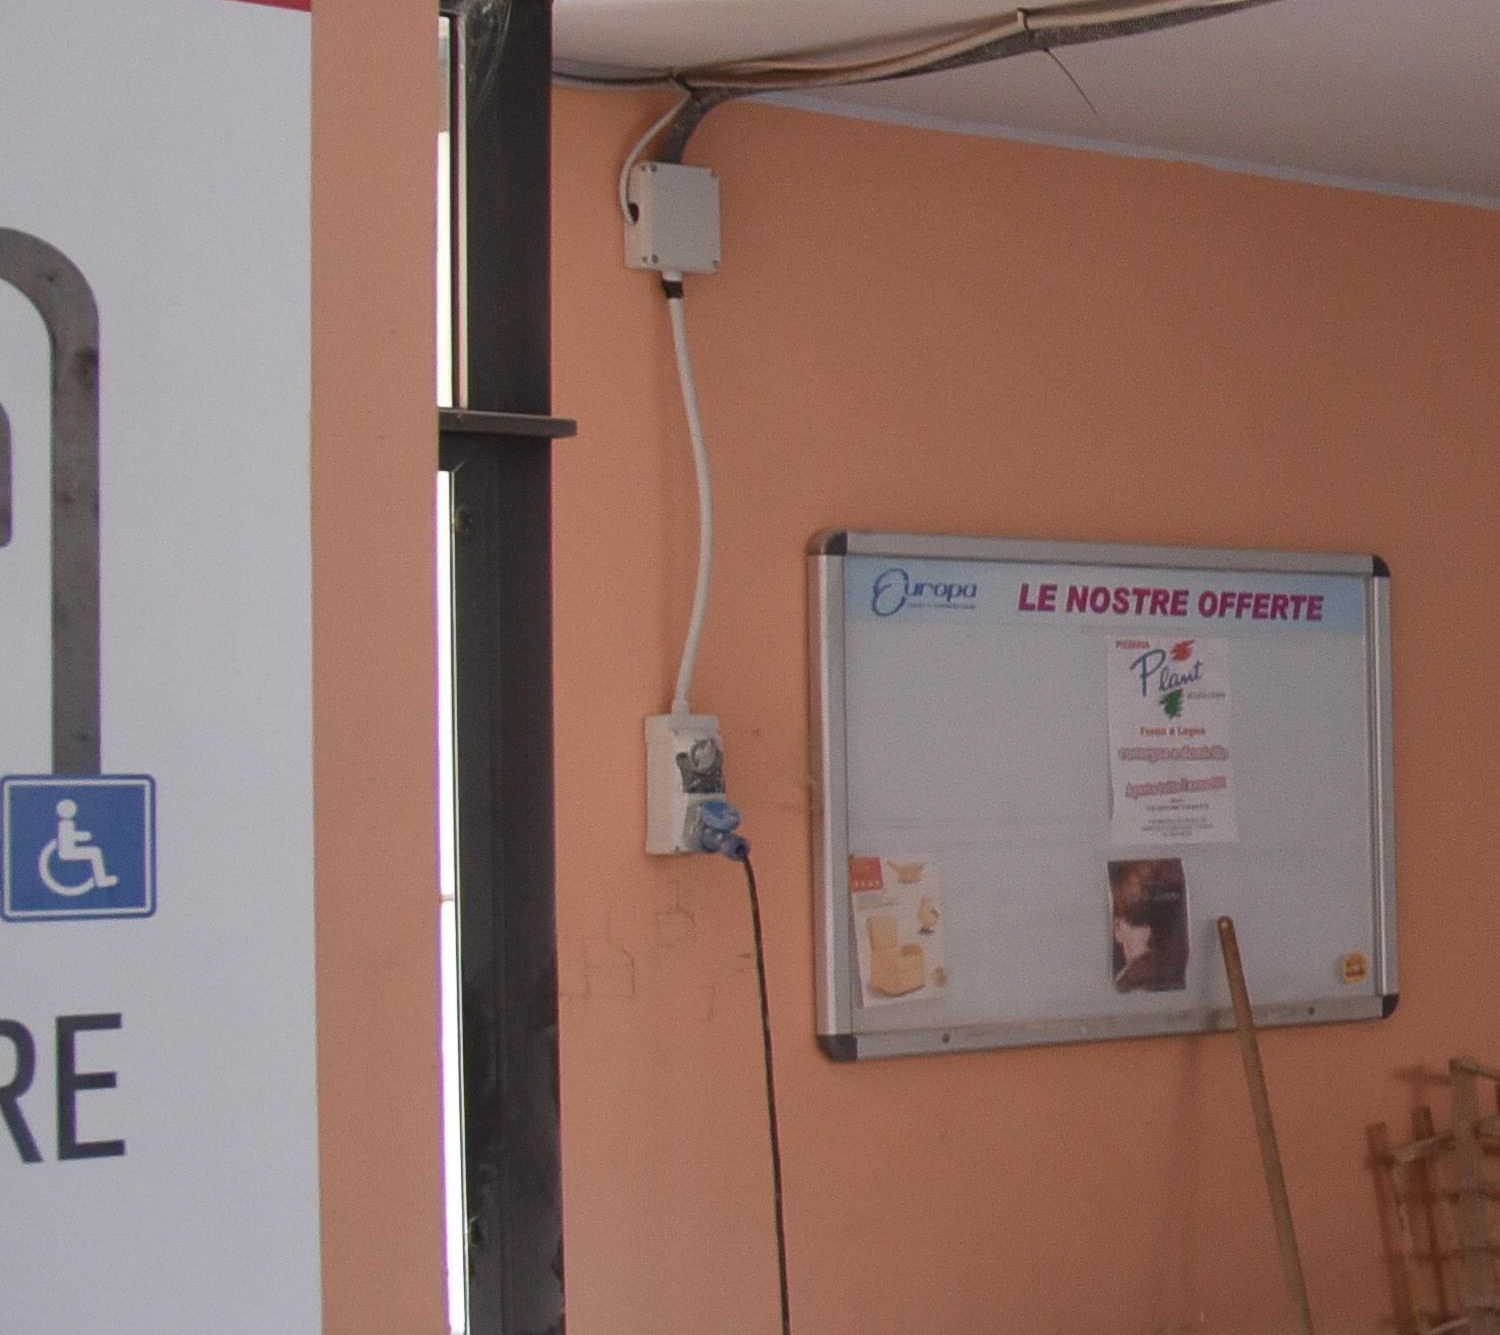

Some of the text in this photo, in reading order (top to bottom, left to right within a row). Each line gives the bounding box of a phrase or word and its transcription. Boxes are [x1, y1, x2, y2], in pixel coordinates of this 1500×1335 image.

[872, 567, 977, 617] Europa
[1018, 583, 1325, 622] LE NOSTRE OFFERTE
